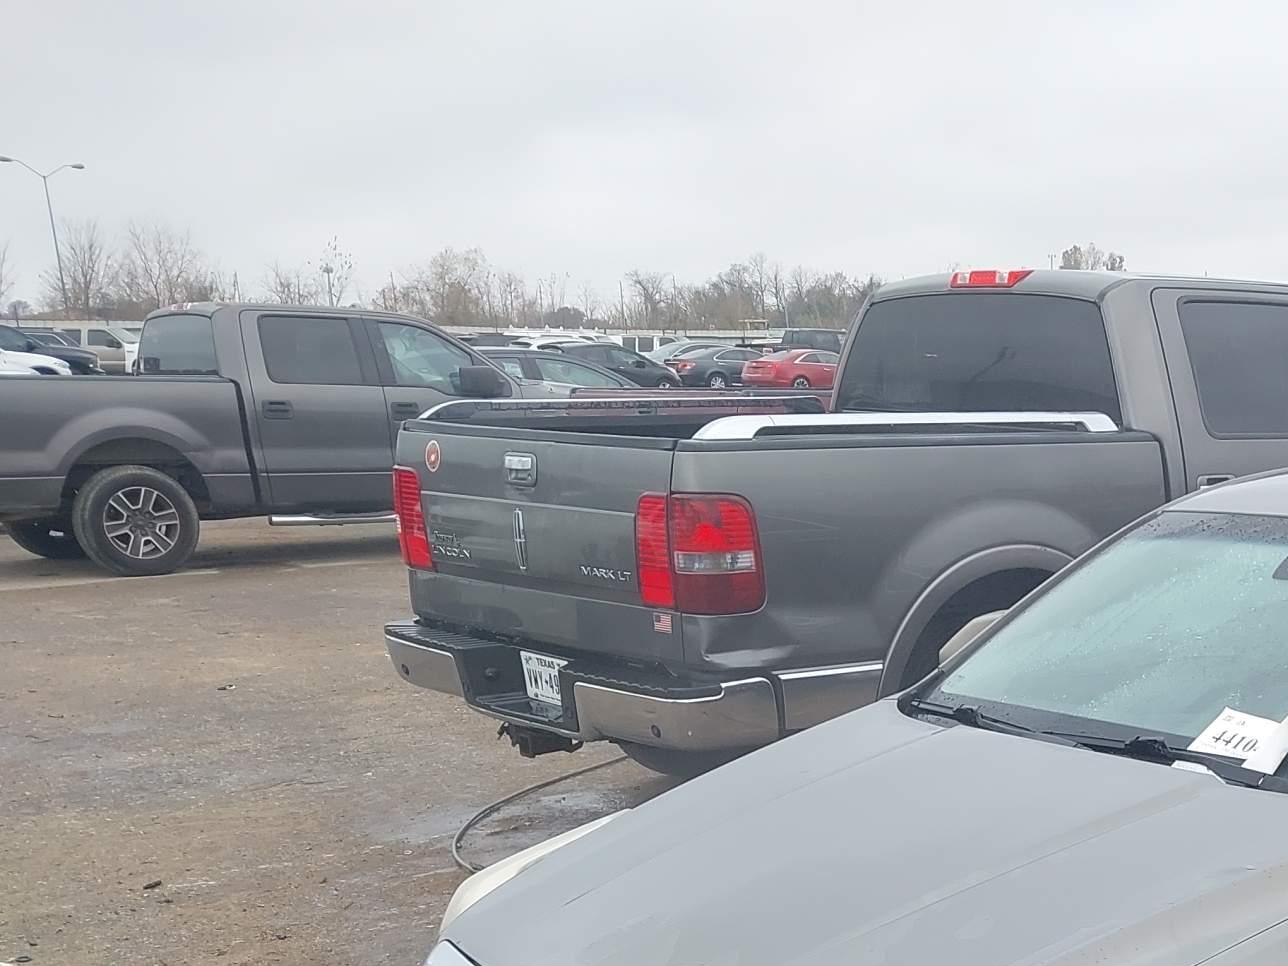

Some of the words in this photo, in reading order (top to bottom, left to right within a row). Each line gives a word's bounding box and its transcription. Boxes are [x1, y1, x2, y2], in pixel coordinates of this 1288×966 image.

[580, 565, 615, 580] MARK
[617, 570, 632, 581] LT
[536, 657, 556, 670] TEXAS
[1212, 730, 1259, 753] 4410
